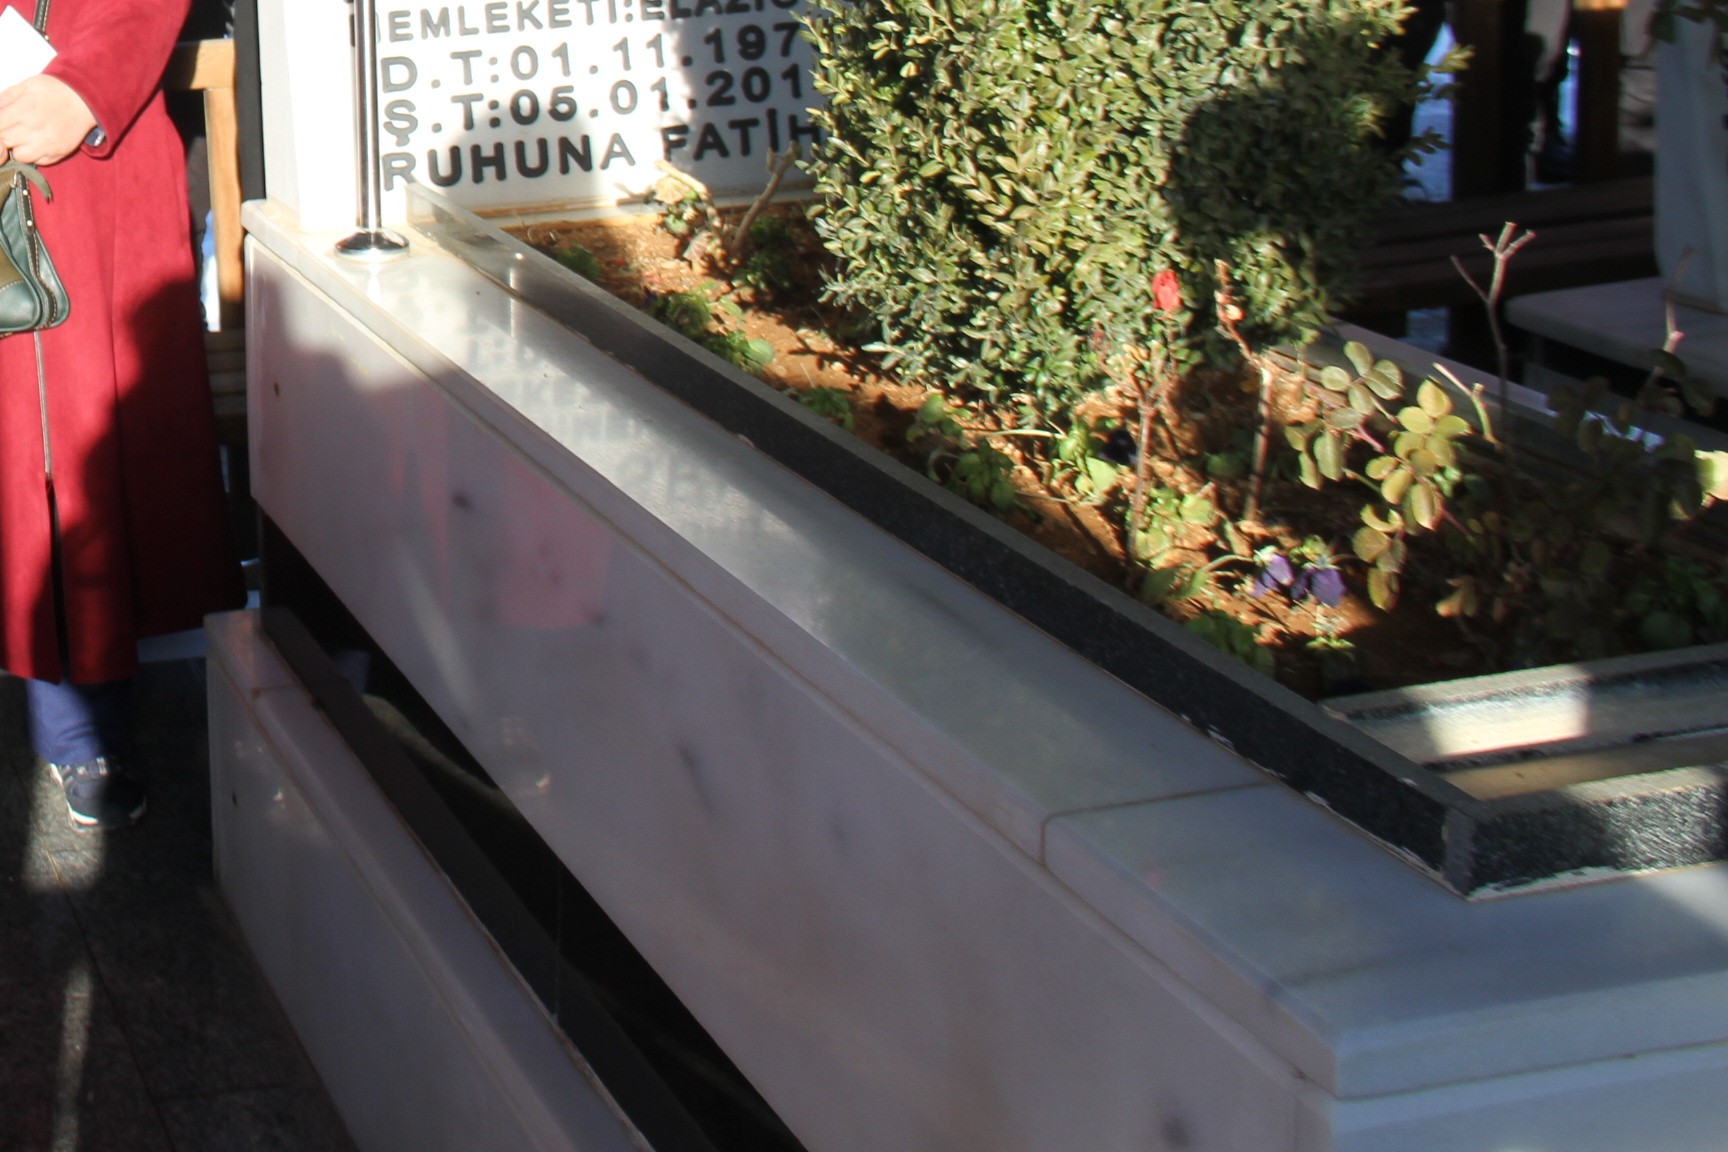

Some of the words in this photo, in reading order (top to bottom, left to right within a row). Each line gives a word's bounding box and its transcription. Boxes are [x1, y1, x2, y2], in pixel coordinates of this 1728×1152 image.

[380, 22, 801, 93] D.T:01.11.197
[382, 63, 803, 147] Ş.T:05.01.201
[382, 132, 636, 191] RUHUNA
[660, 108, 821, 162] FATİH
